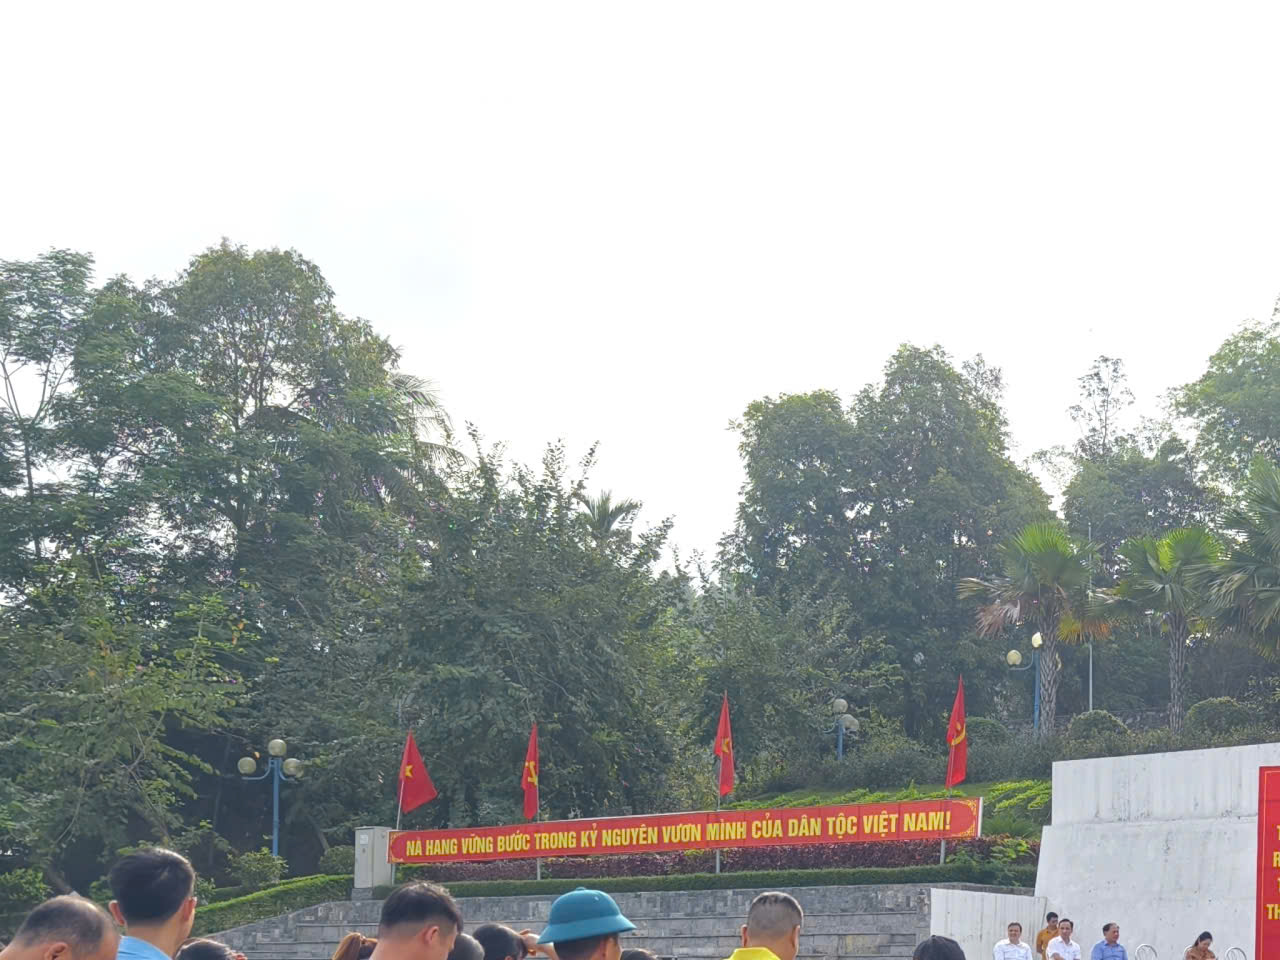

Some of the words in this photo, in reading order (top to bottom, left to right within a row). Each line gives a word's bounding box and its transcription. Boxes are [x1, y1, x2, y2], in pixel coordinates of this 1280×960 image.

[406, 837, 423, 857] NÀ
[425, 838, 458, 856] HANG
[461, 833, 493, 854] VỮNG
[497, 829, 530, 852] BƯỚC
[534, 831, 576, 850] TRONG
[580, 823, 598, 848] KỶ
[602, 823, 658, 847] NGUYÊN
[662, 822, 701, 843] VƯƠN
[706, 818, 746, 841] MÌNH
[751, 812, 783, 838] CỦA
[788, 813, 822, 837] DÂN
[826, 812, 858, 839] TỘC
[862, 810, 899, 838] VIỆT
[903, 811, 951, 833] NAM!
